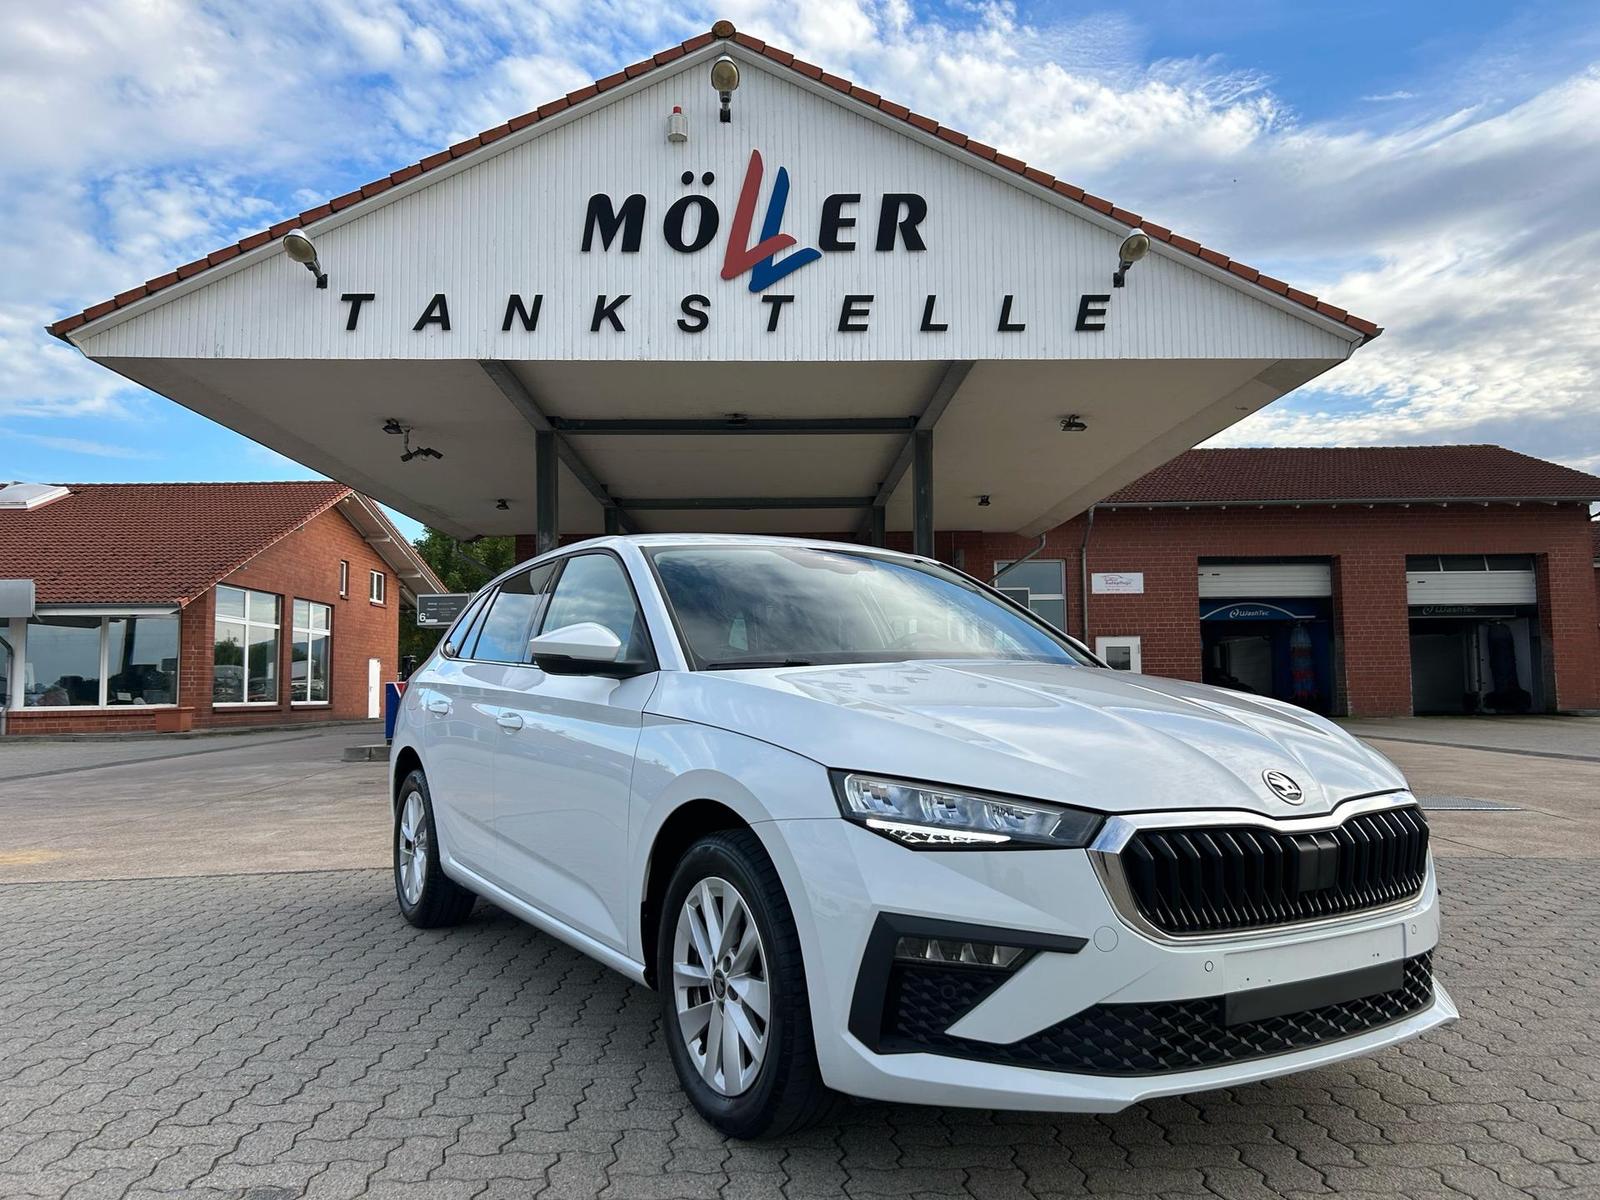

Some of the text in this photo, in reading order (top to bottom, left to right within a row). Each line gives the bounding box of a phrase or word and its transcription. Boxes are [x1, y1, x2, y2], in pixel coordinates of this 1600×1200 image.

[580, 149, 929, 293] MÖLLER
[341, 293, 1112, 334] TANKSTELLE
[1239, 609, 1270, 617] WashTec
